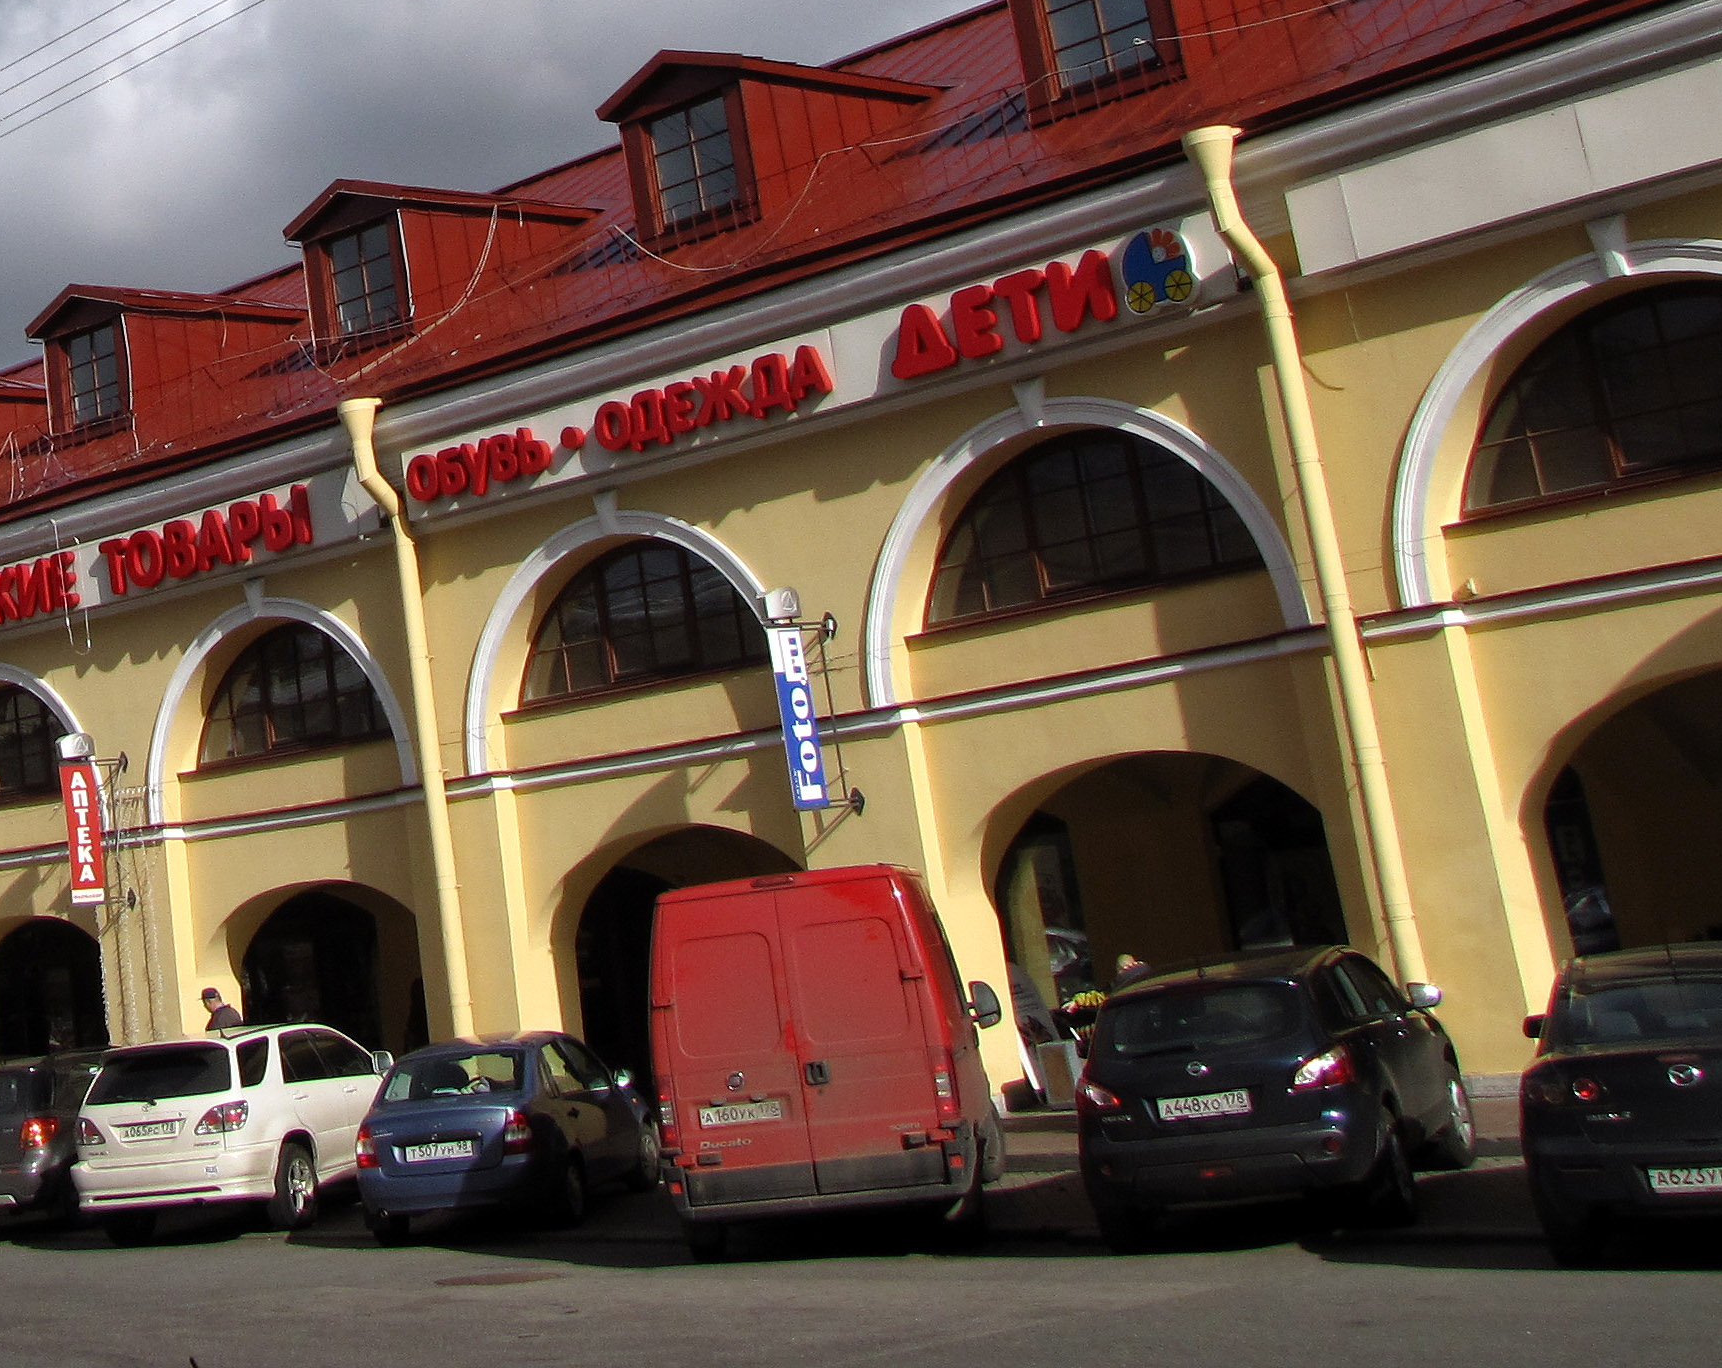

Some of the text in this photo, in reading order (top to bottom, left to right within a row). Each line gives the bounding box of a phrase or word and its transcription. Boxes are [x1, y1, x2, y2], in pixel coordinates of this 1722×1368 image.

[890, 249, 1118, 379] ДЕТИ
[406, 345, 835, 502] ОБУВЬ ОДЕЖДА
[99, 484, 313, 595] ТОВАРЫ
[71, 771, 96, 882] АПТЕКА
[705, 1107, 755, 1123] А160УК
[1164, 1092, 1244, 1115] А448ХО 178
[411, 1143, 454, 1158] Т507УН
[700, 1138, 751, 1149] Ducato
[1657, 1168, 1722, 1185] А623У
